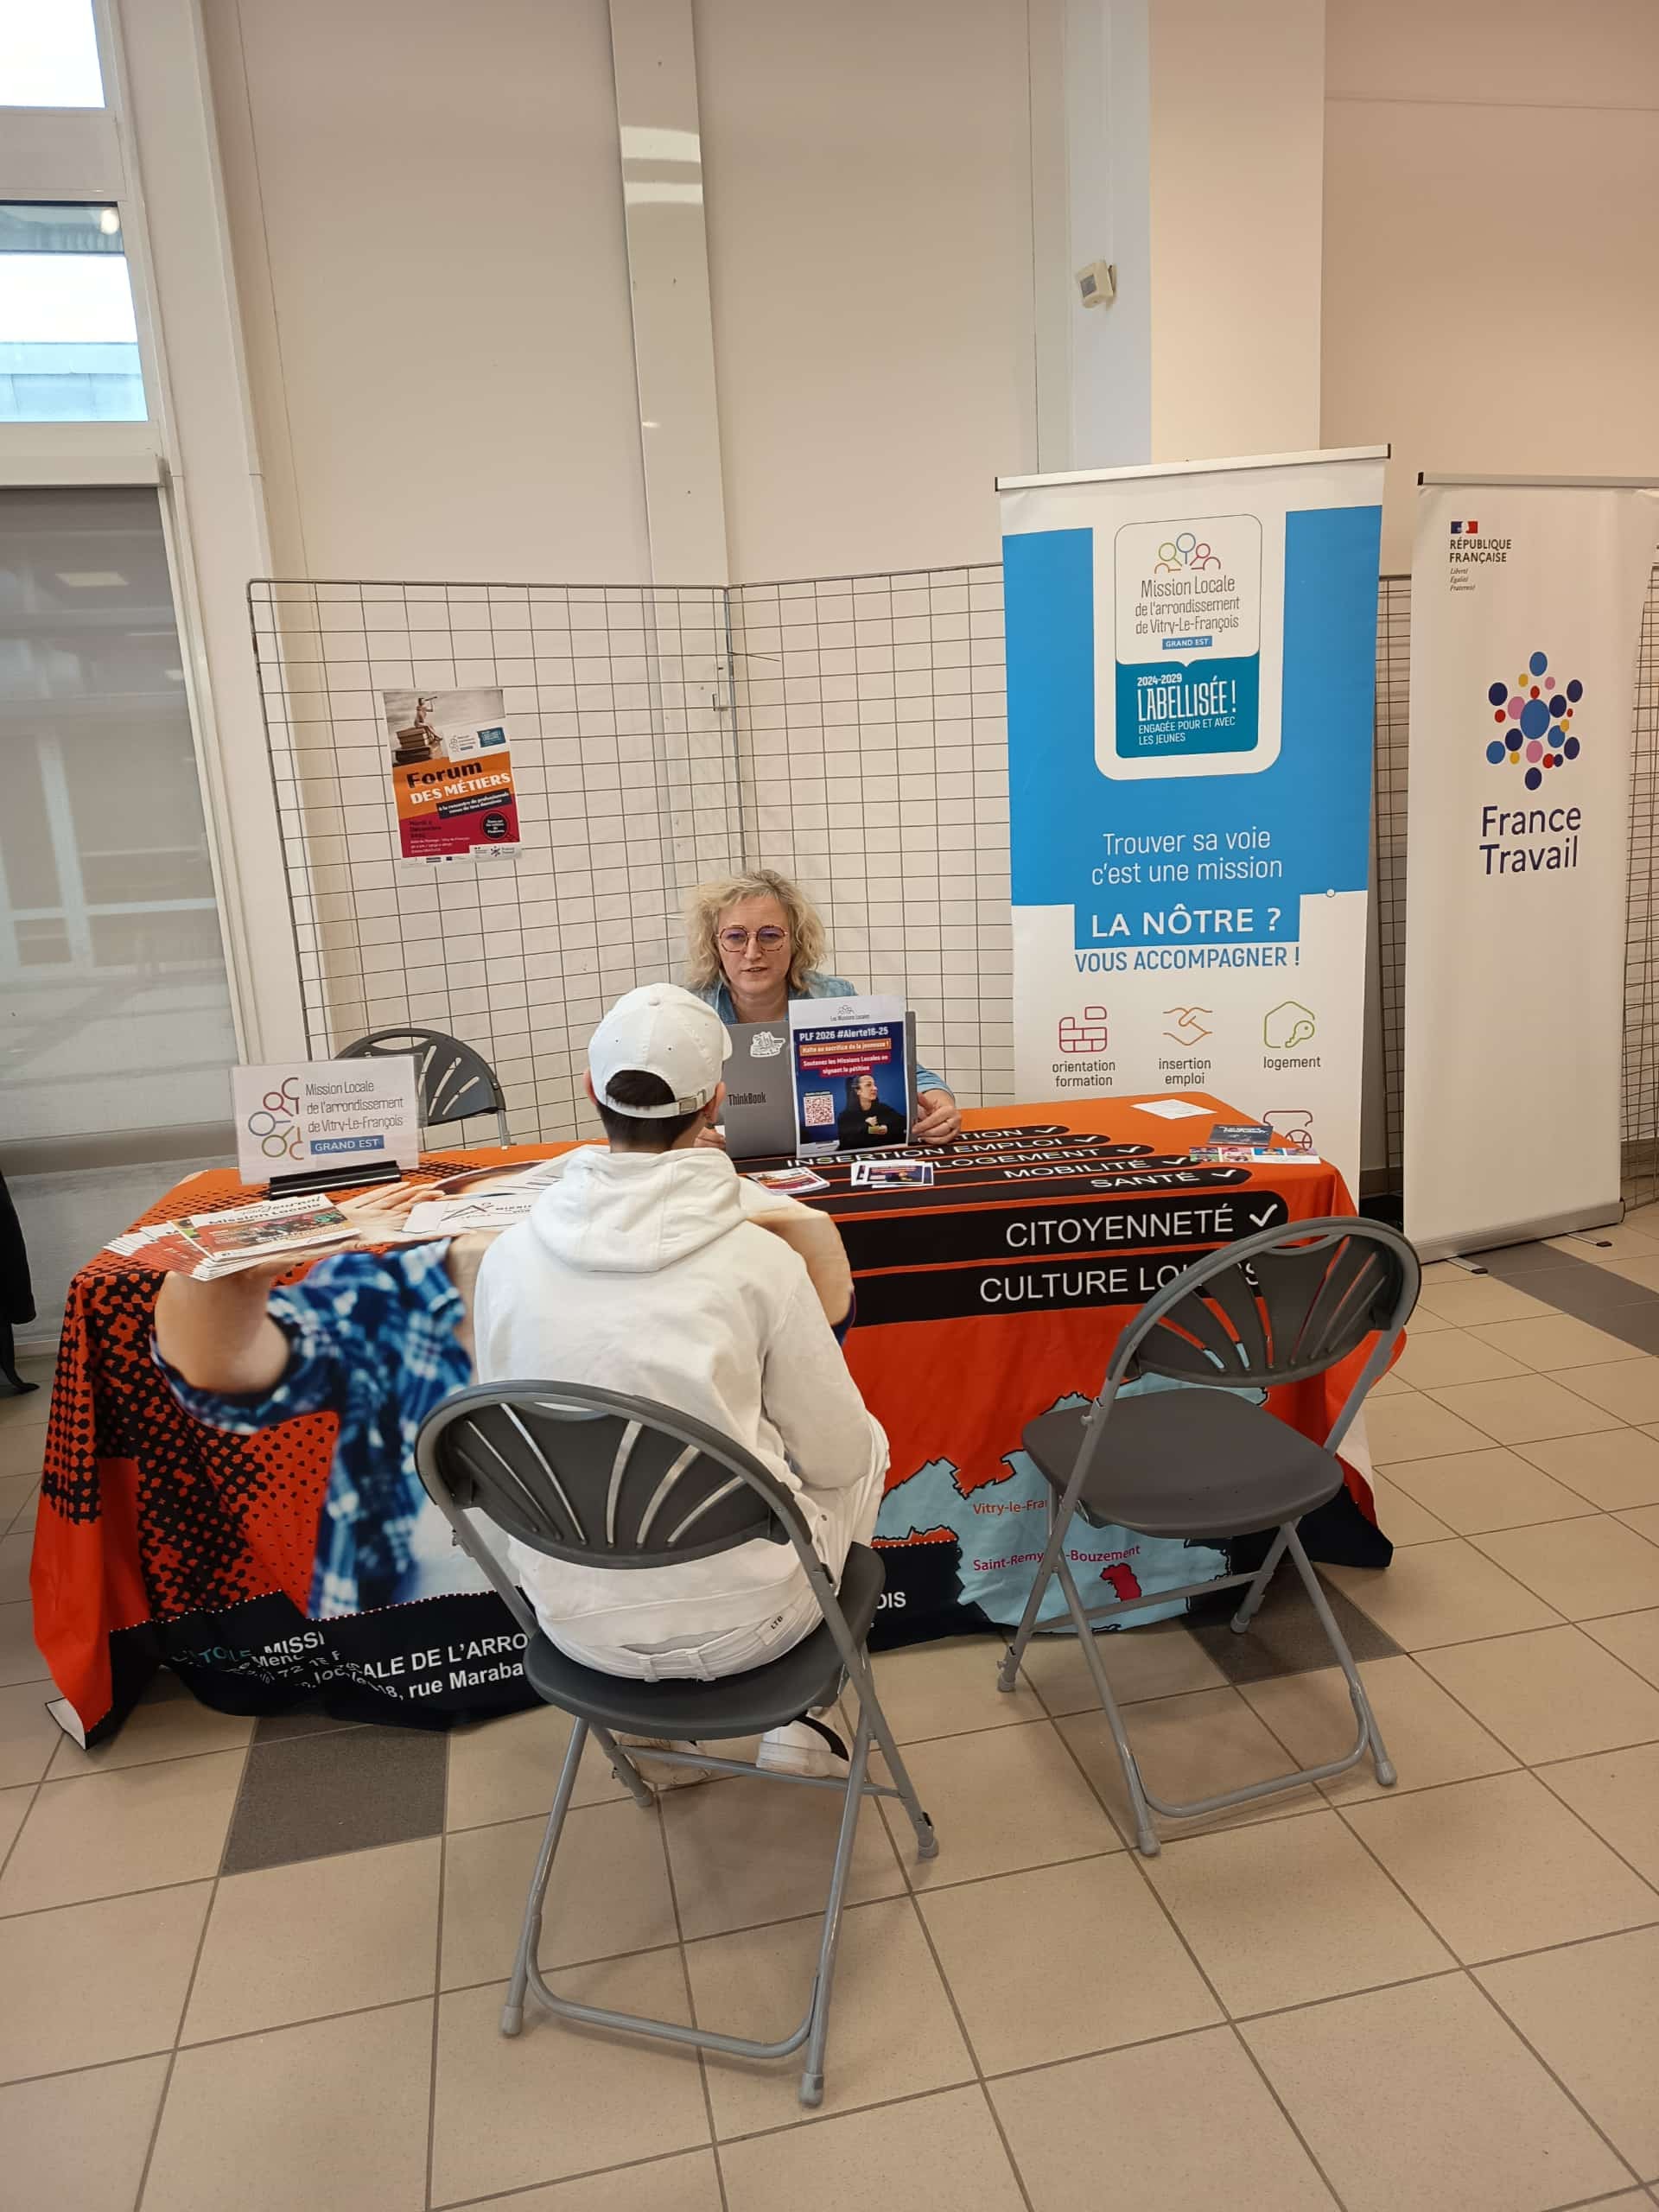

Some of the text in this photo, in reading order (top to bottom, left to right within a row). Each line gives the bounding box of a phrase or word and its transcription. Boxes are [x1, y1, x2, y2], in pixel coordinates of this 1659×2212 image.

[1450, 537, 1512, 551] RÉPUBLIQUE
[1449, 552, 1507, 564] FRANÇAISE
[1141, 575, 1236, 599] Mission Locale
[1135, 597, 1240, 618] de l'arrondissement
[1135, 615, 1239, 635] de Vitry-Le-François
[1166, 638, 1209, 648] GRAND EST
[1137, 673, 1183, 687] 2024-2029
[1137, 676, 1228, 721] LABELLISÉE
[1138, 715, 1236, 734] ENGAGÉE POUR ET AVEC
[1139, 732, 1186, 746] LES JEUNES
[406, 762, 483, 789] Forum
[410, 772, 512, 804] DES MÉTIERS
[1481, 805, 1581, 837] France
[1103, 826, 1272, 856] Trouver sa voie
[1479, 835, 1578, 875] Travail
[1091, 855, 1283, 886] c'est une mission
[1091, 903, 1282, 938] LA NÔTRE ?
[1075, 946, 1300, 973] VOUS ACCOMPAGNER !
[799, 1027, 889, 1041] PLF 2026 #Alerte16-25
[1052, 1058, 1116, 1073] orientation
[1158, 1057, 1211, 1071] insertion
[1263, 1055, 1321, 1071] logement
[306, 1080, 374, 1096] Mission Locale
[1055, 1073, 1113, 1087] formation
[1165, 1071, 1205, 1086] emploi
[307, 1097, 404, 1115] de l'arrondissement
[728, 1091, 766, 1106] ThinkBook
[308, 1116, 403, 1133] de Vitry-Le-François
[958, 1128, 1023, 1140] TION
[315, 1138, 379, 1152] GRAND EST
[787, 1147, 944, 1166] INSERTION
[953, 1138, 1063, 1154] EMPLOI
[934, 1147, 1101, 1168] LOGEMENT
[1004, 1158, 1152, 1179] MOBILITÉ
[1090, 1171, 1200, 1188] SANTÉ
[1006, 1203, 1234, 1247] CITOYENNETÉ
[980, 1268, 1128, 1302] CULTURE
[973, 1498, 1048, 1516] Vitry-le-Fra
[264, 1630, 325, 1654] MISSI
[411, 1649, 442, 1671] DE
[409, 1680, 442, 1699] rue
[448, 1662, 524, 1690] Maraba
